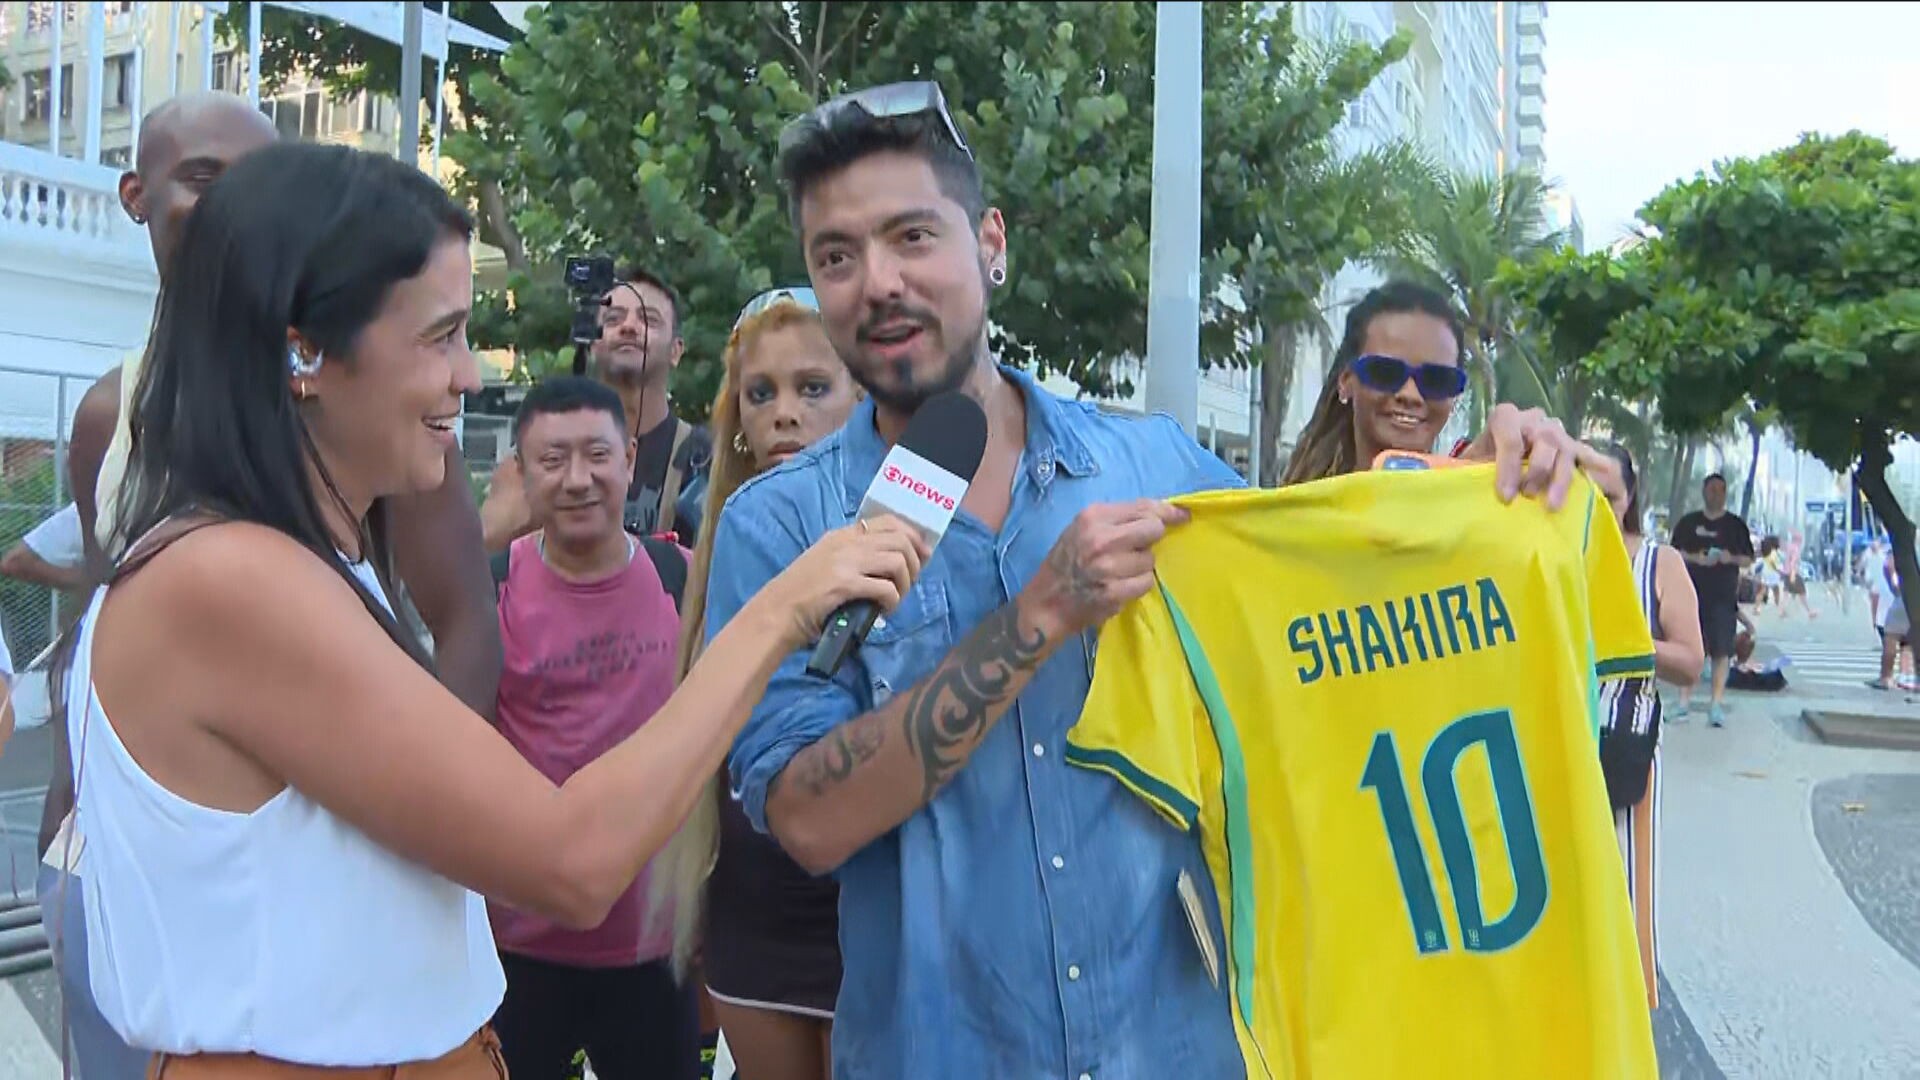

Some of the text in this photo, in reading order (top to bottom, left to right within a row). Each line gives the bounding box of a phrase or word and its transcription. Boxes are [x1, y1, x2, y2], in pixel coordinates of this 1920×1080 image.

[900, 474, 955, 511] news
[1287, 577, 1517, 684] SHAKIRA
[1358, 708, 1550, 955] 10
